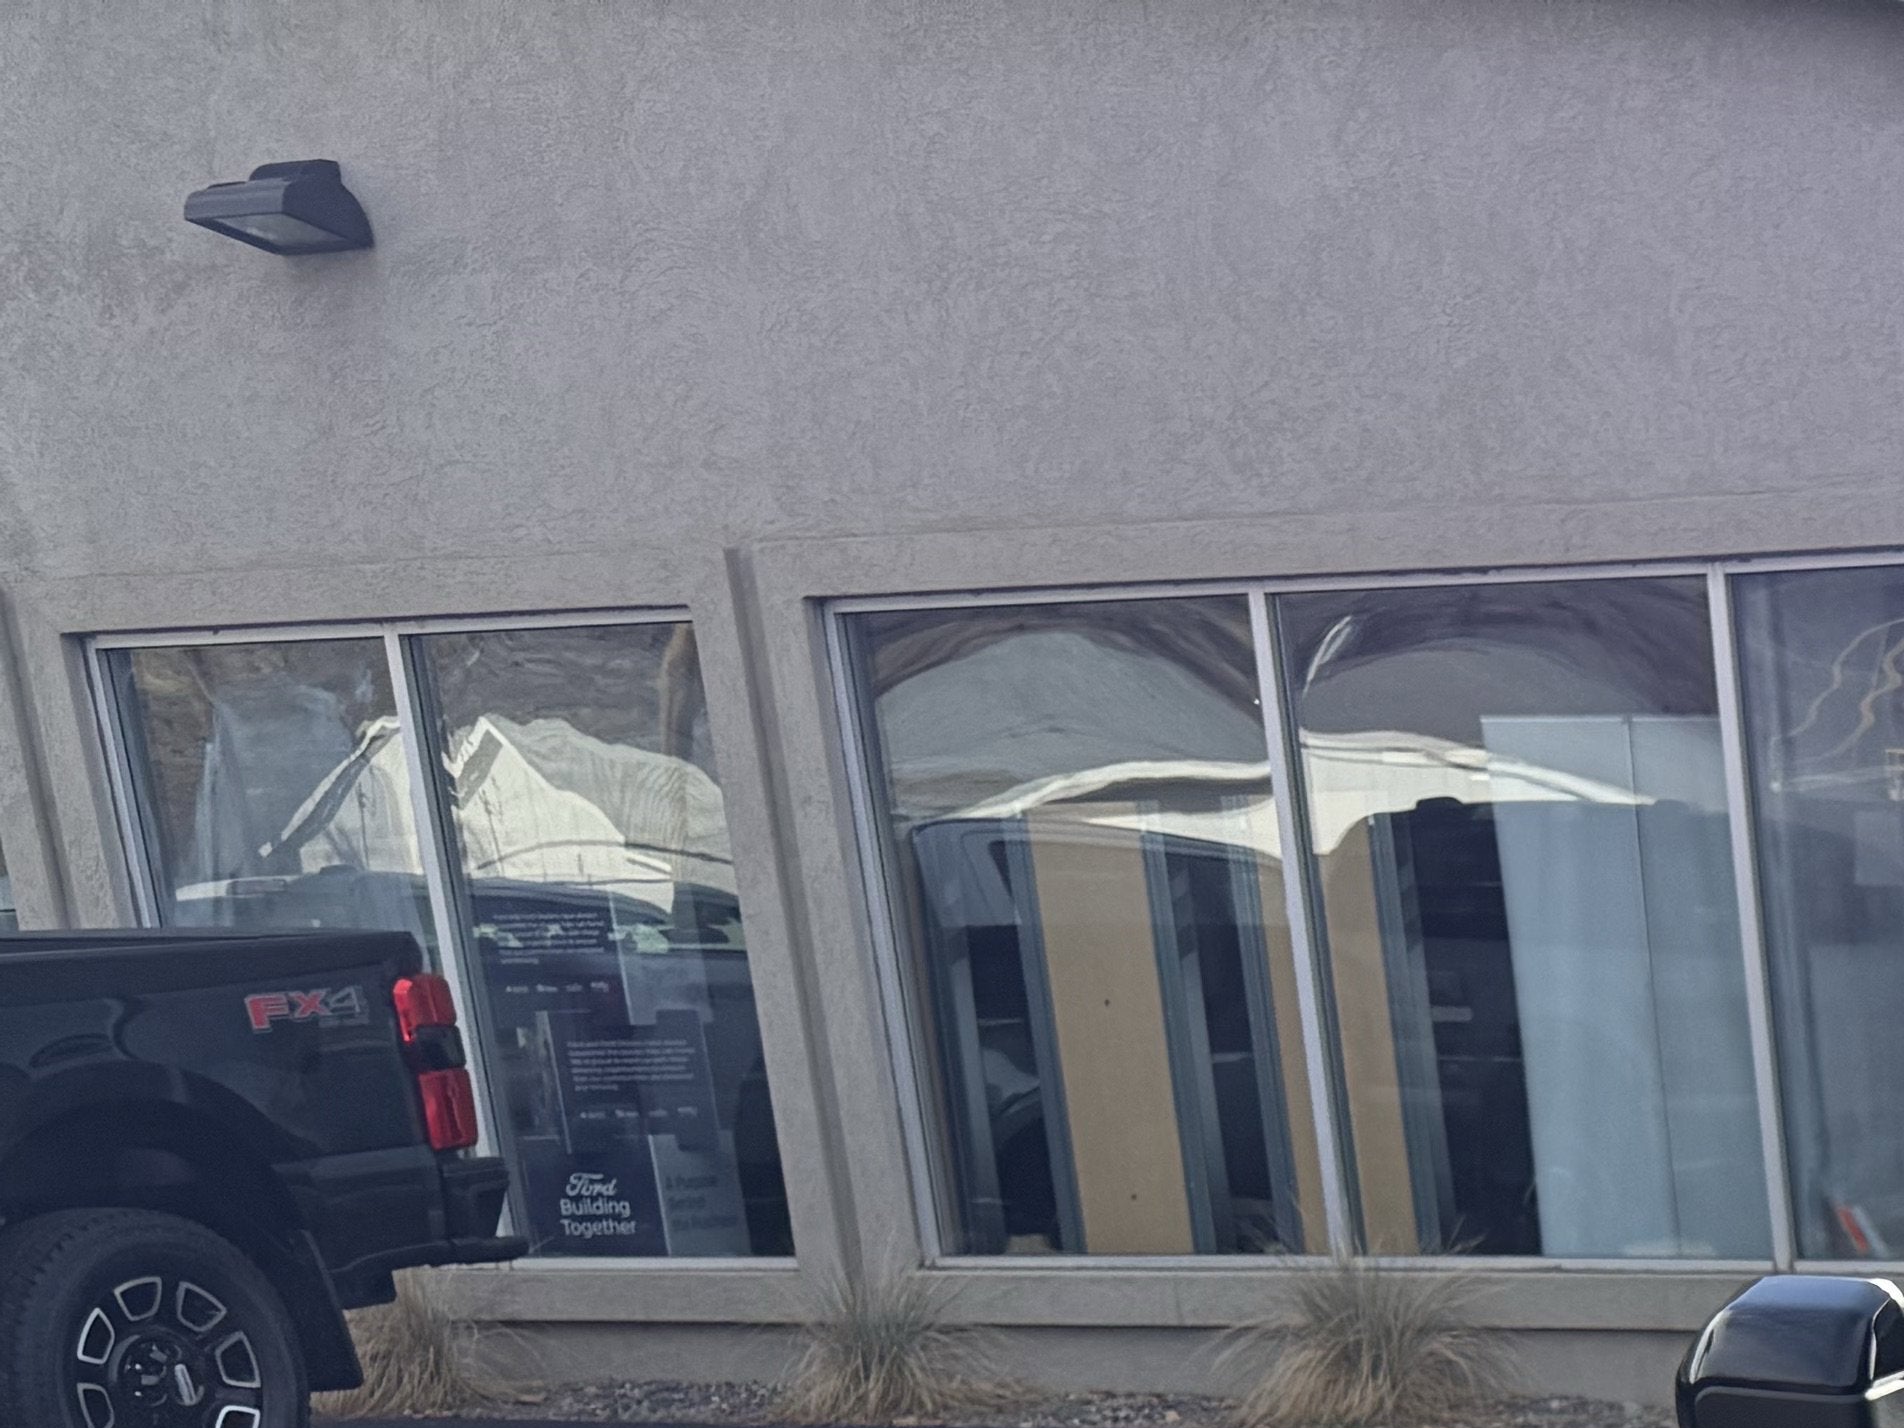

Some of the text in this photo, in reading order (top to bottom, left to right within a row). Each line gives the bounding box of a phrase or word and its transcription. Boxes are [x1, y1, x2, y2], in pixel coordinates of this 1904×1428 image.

[243, 986, 369, 1034] FX4
[565, 1172, 618, 1197] Ford
[560, 1198, 631, 1218] Building
[560, 1218, 637, 1239] Together
